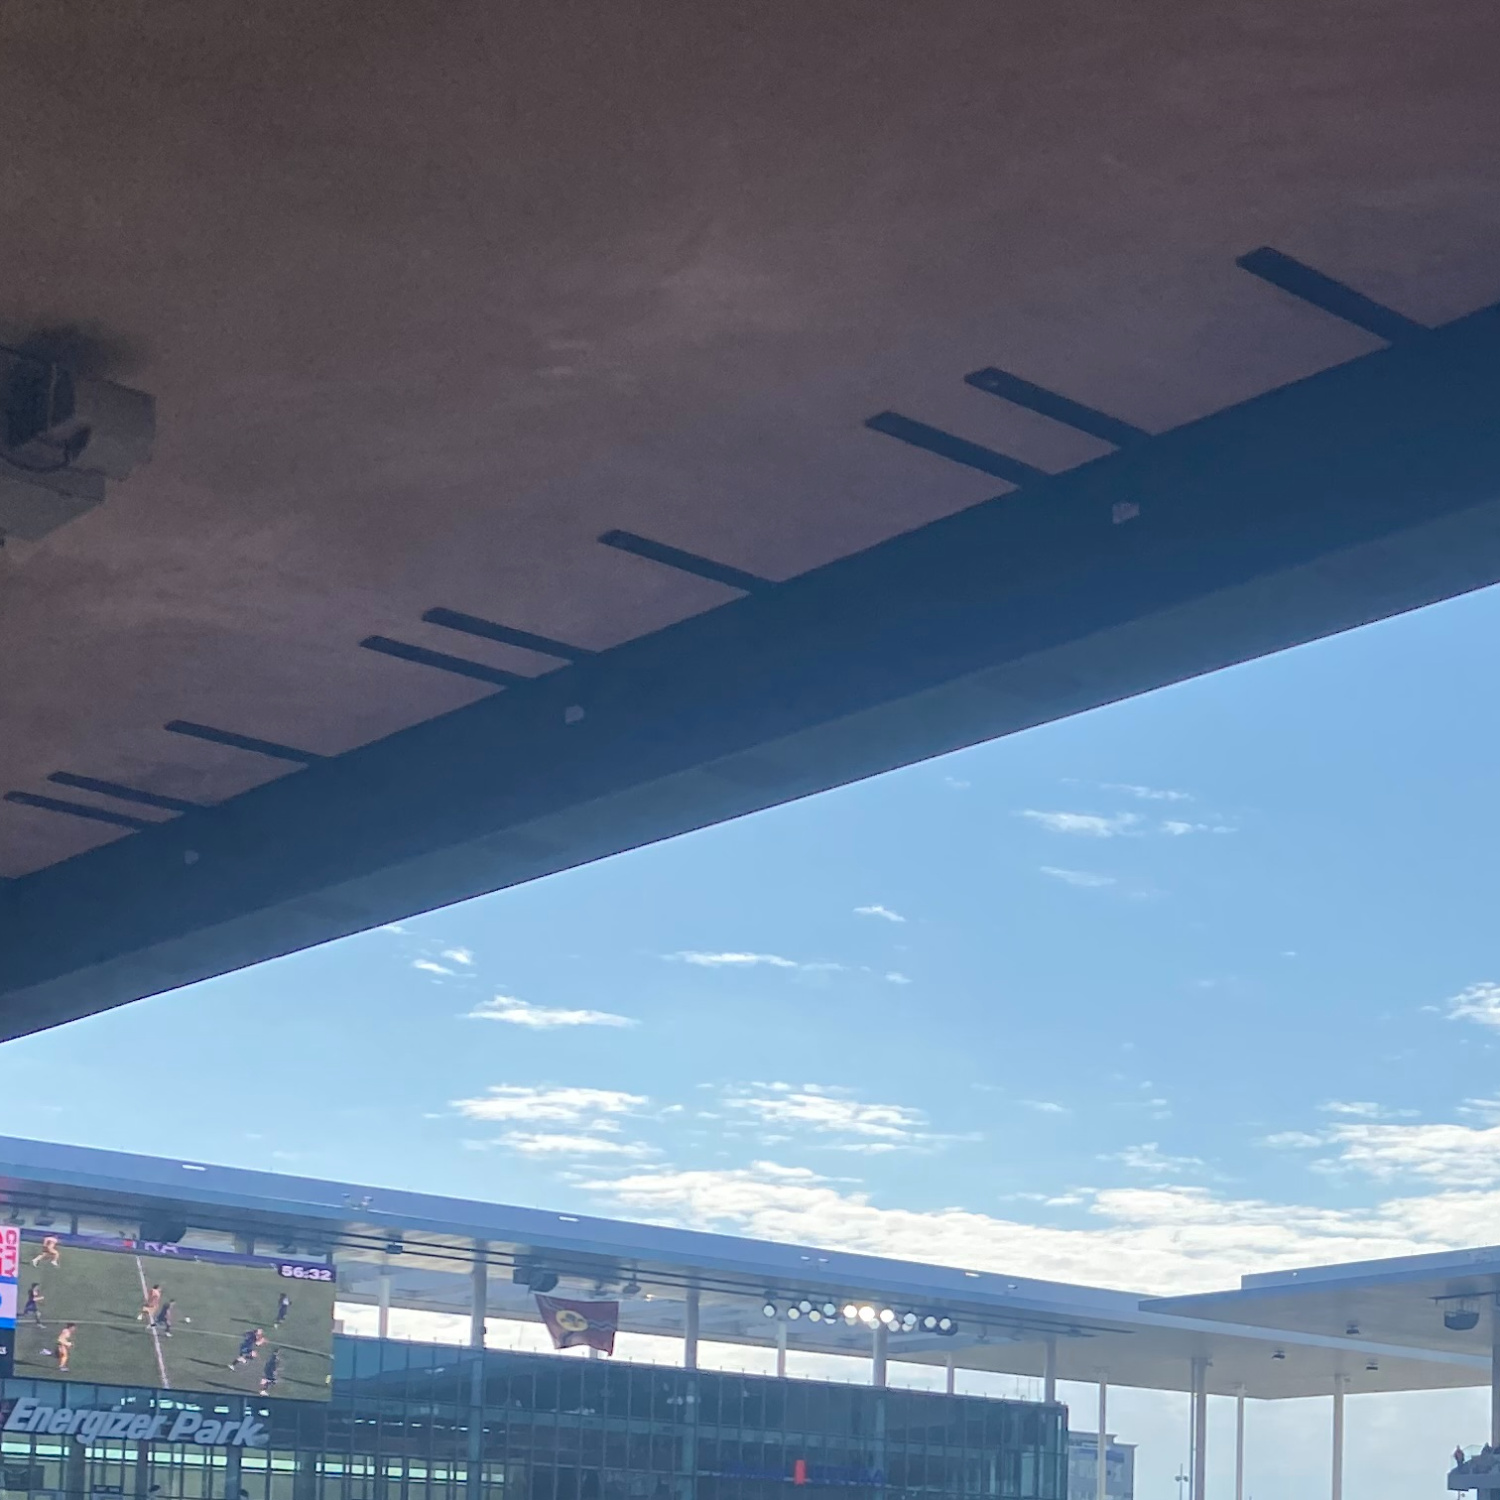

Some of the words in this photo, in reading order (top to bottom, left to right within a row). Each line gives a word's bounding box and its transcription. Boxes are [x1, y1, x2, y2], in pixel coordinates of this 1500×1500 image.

[281, 1265, 332, 1281] 56:32
[3, 1396, 168, 1444] Energizer
[168, 1411, 265, 1447] Park
